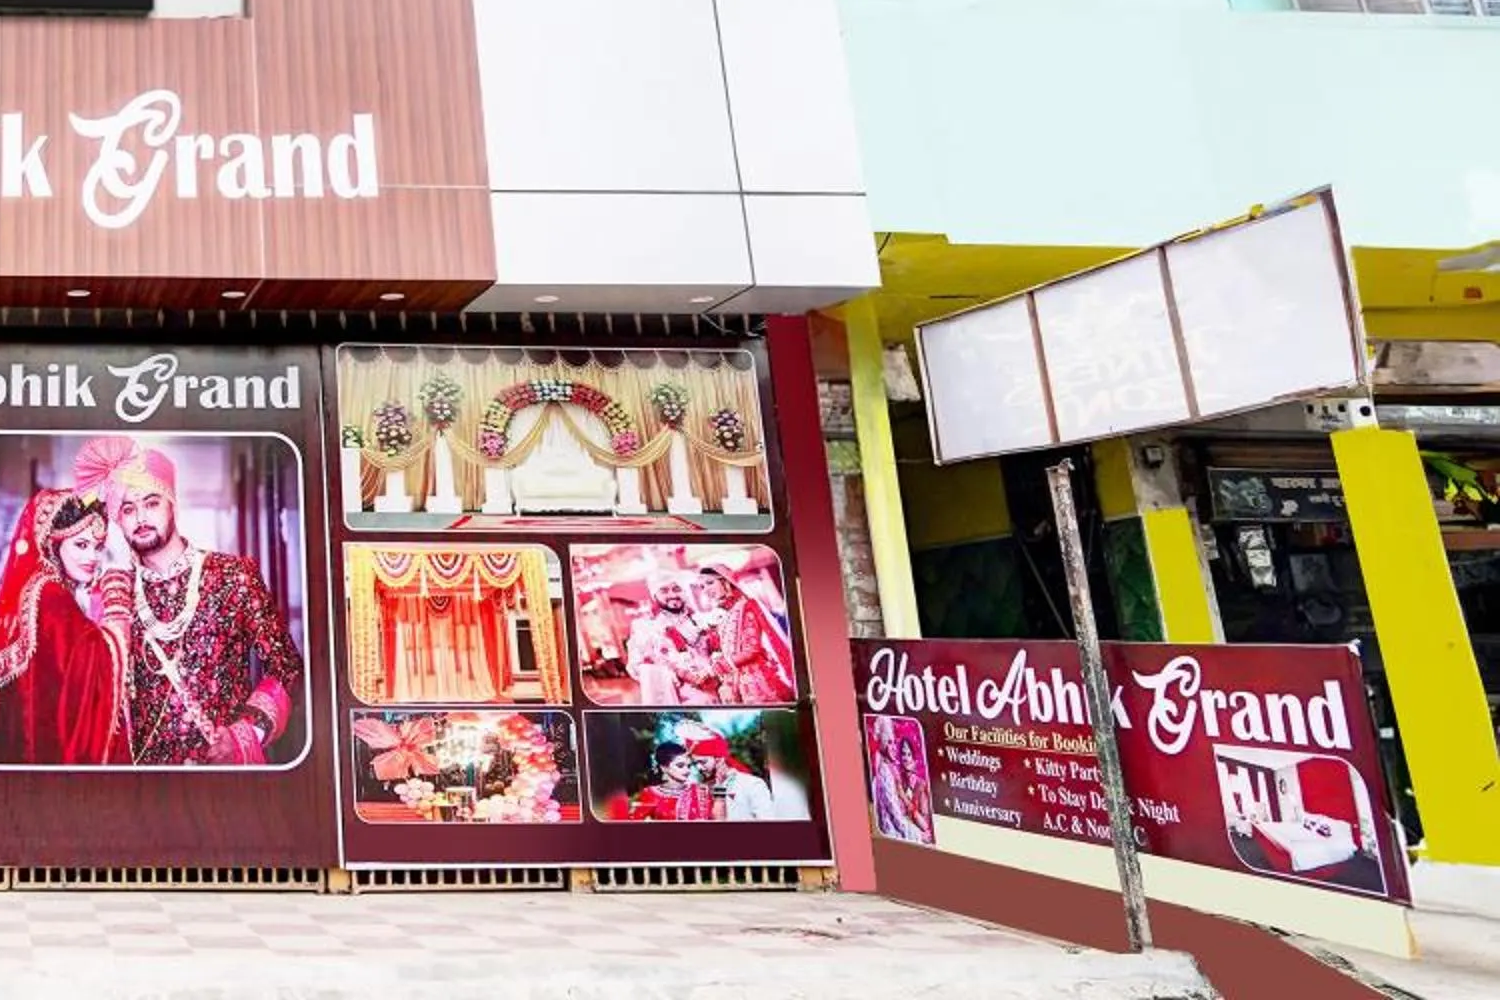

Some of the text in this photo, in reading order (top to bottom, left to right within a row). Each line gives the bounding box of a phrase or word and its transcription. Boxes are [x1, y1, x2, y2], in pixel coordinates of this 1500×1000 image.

[69, 89, 379, 229] Grand
[107, 352, 300, 422] Grand
[866, 648, 970, 715] Hotel
[1132, 655, 1351, 754] Grand
[944, 723, 1098, 753] Our Facilities for Booki
[946, 747, 1001, 772] Weddings
[1035, 758, 1067, 779] Kitty
[950, 772, 998, 797] Birthday
[954, 798, 1022, 828] Anniversary
[1038, 784, 1056, 803] To
[1057, 788, 1087, 812] Stay
[1138, 798, 1180, 823] Night
[1044, 813, 1068, 833] A.C
[1071, 816, 1083, 834] &
